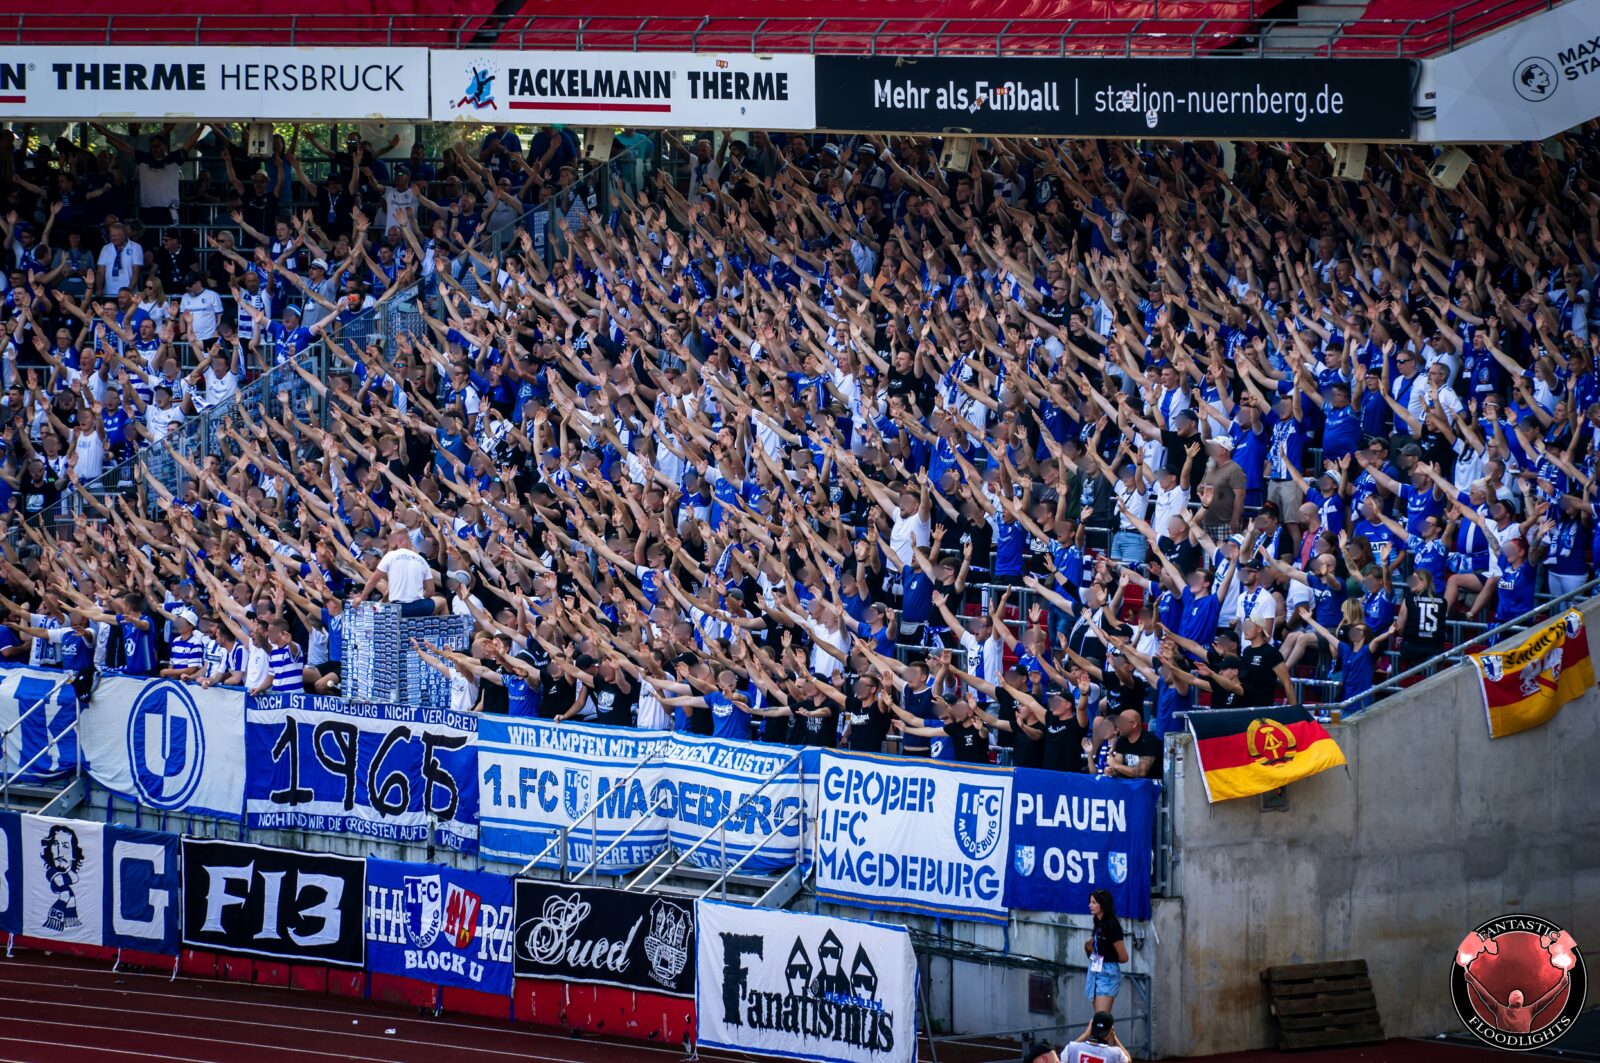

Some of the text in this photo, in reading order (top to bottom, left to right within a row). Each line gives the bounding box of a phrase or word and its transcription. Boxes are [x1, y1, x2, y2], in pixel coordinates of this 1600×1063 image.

[52, 63, 206, 91] THERME
[221, 64, 404, 91] HERSBRUCK
[688, 70, 788, 100] THERME
[874, 79, 1060, 111] Mehr als Fußball
[1094, 82, 1344, 122] stadion-nuernberg.de
[1418, 603, 1438, 631] 15
[255, 694, 477, 732] NOCH IST MAGDEBURG NICHT VERLOREN
[270, 715, 468, 822] 1965
[508, 726, 537, 746] WIR
[540, 728, 607, 757] KÄMPFEN
[609, 740, 635, 758] MIT
[714, 747, 787, 776] FÄUSTEN
[484, 764, 559, 813] 1.FC
[960, 791, 999, 817] 1.FC
[258, 813, 285, 827] NOCH
[286, 812, 307, 827] IND
[308, 815, 325, 830] WIR
[328, 817, 342, 831] DIE
[345, 817, 397, 840] GRÖSSTEN
[400, 827, 419, 841] AUF
[821, 808, 868, 847] 1.FC
[1015, 792, 1126, 832] PLAUEN
[442, 830, 464, 850] WELT
[957, 818, 998, 854] MAGDEBURG
[818, 844, 1000, 901] MAGDEBURG
[1043, 847, 1099, 884] OST
[50, 908, 63, 920] BG
[404, 950, 485, 983] BLOCK U
